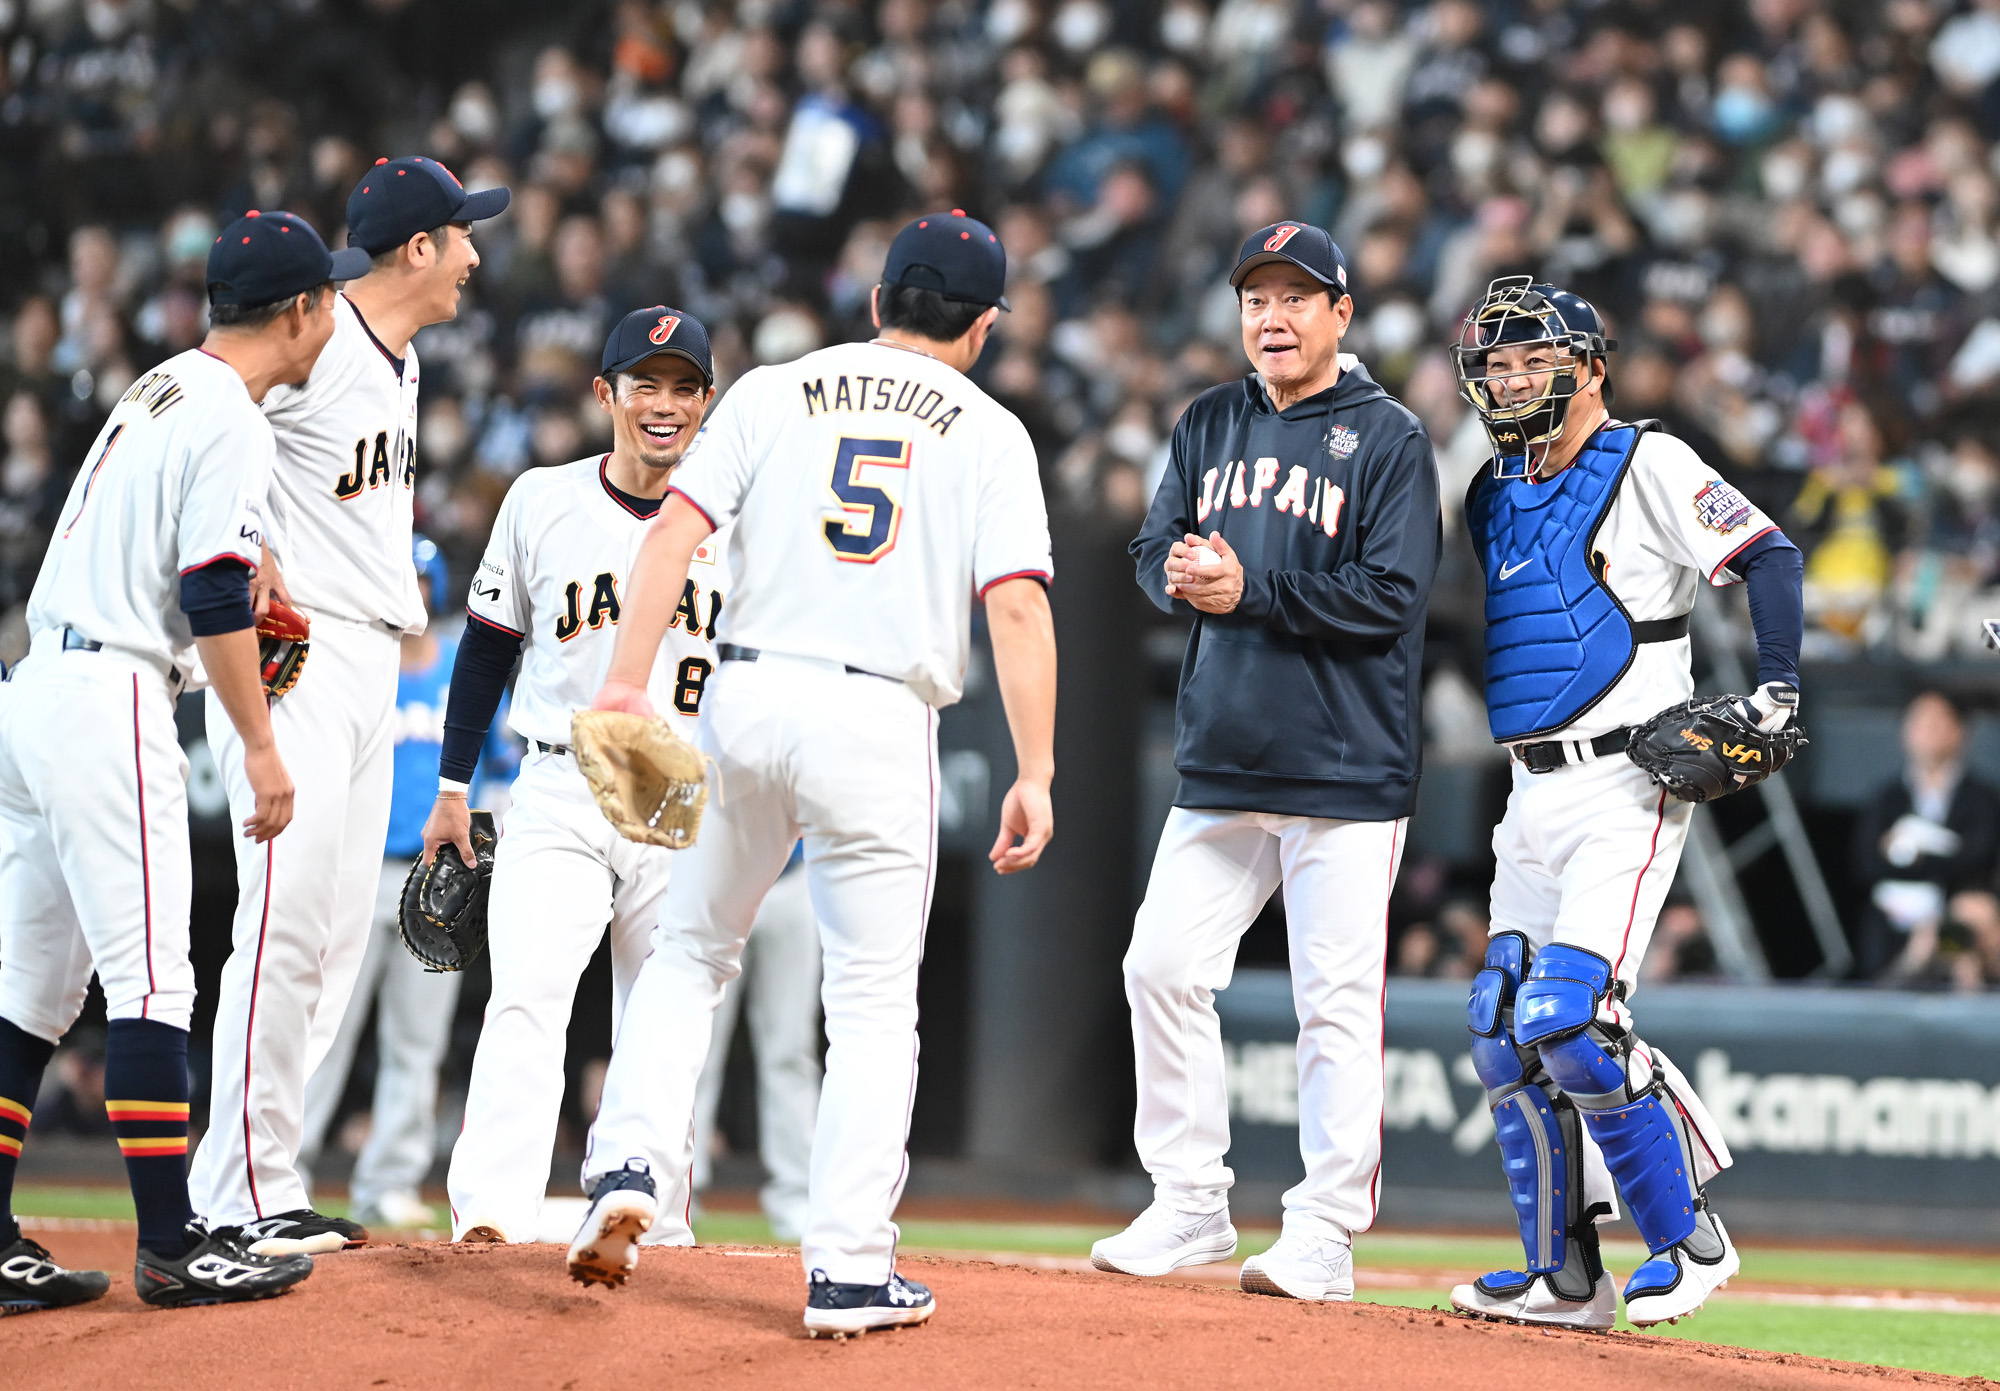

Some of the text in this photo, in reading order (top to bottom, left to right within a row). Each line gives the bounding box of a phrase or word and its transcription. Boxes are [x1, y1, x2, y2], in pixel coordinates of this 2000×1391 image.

[649, 315, 681, 345] J
[802, 375, 963, 436] MATSUDA
[63, 421, 127, 539] 1
[333, 429, 417, 501] JAA
[821, 433, 912, 564] 5
[1197, 457, 1345, 539] JAPAN
[1695, 483, 1730, 514] DREA
[1699, 493, 1742, 527] PLAYE
[555, 571, 724, 643] JAA
[1695, 1048, 2000, 1158] kanam
